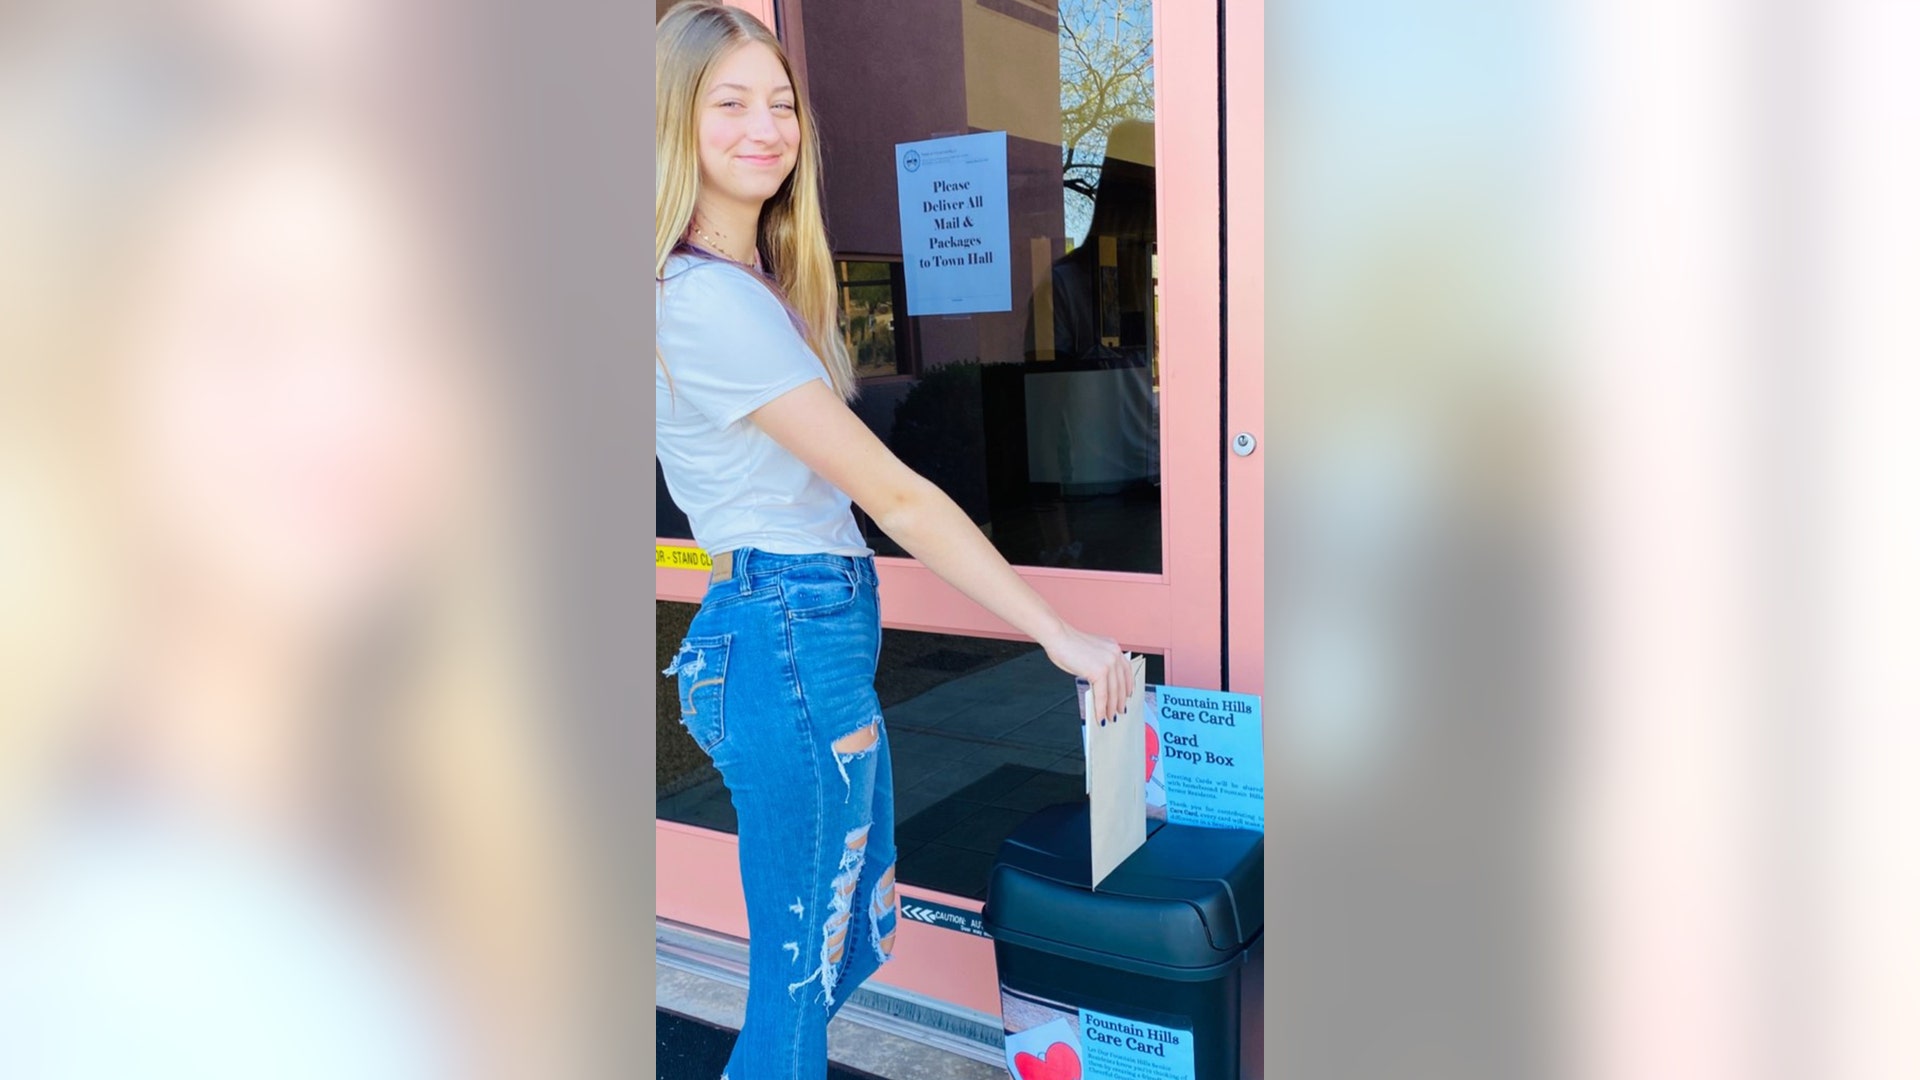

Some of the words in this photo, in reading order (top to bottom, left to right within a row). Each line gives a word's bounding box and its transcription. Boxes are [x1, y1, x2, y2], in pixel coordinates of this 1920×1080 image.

[933, 180, 970, 193] Please
[923, 199, 965, 213] Deliver
[967, 196, 983, 209] All
[934, 217, 960, 231] Mail
[963, 216, 974, 228] &
[929, 236, 981, 250] Packages
[920, 258, 930, 268] to
[932, 255, 965, 268] Town
[968, 252, 993, 266] Hall
[672, 551, 698, 566] STAND
[1163, 694, 1219, 710] Fountain
[1222, 700, 1252, 714] Hills
[1161, 707, 1195, 722] Care
[1199, 711, 1236, 727] Card
[1163, 731, 1199, 747] Card
[1164, 745, 1202, 764] Drop
[1205, 751, 1234, 767] Box
[1085, 1013, 1143, 1037] Fountain
[1147, 1030, 1180, 1046] Hills
[1086, 1028, 1122, 1047] Care
[1125, 1038, 1165, 1058] Card
